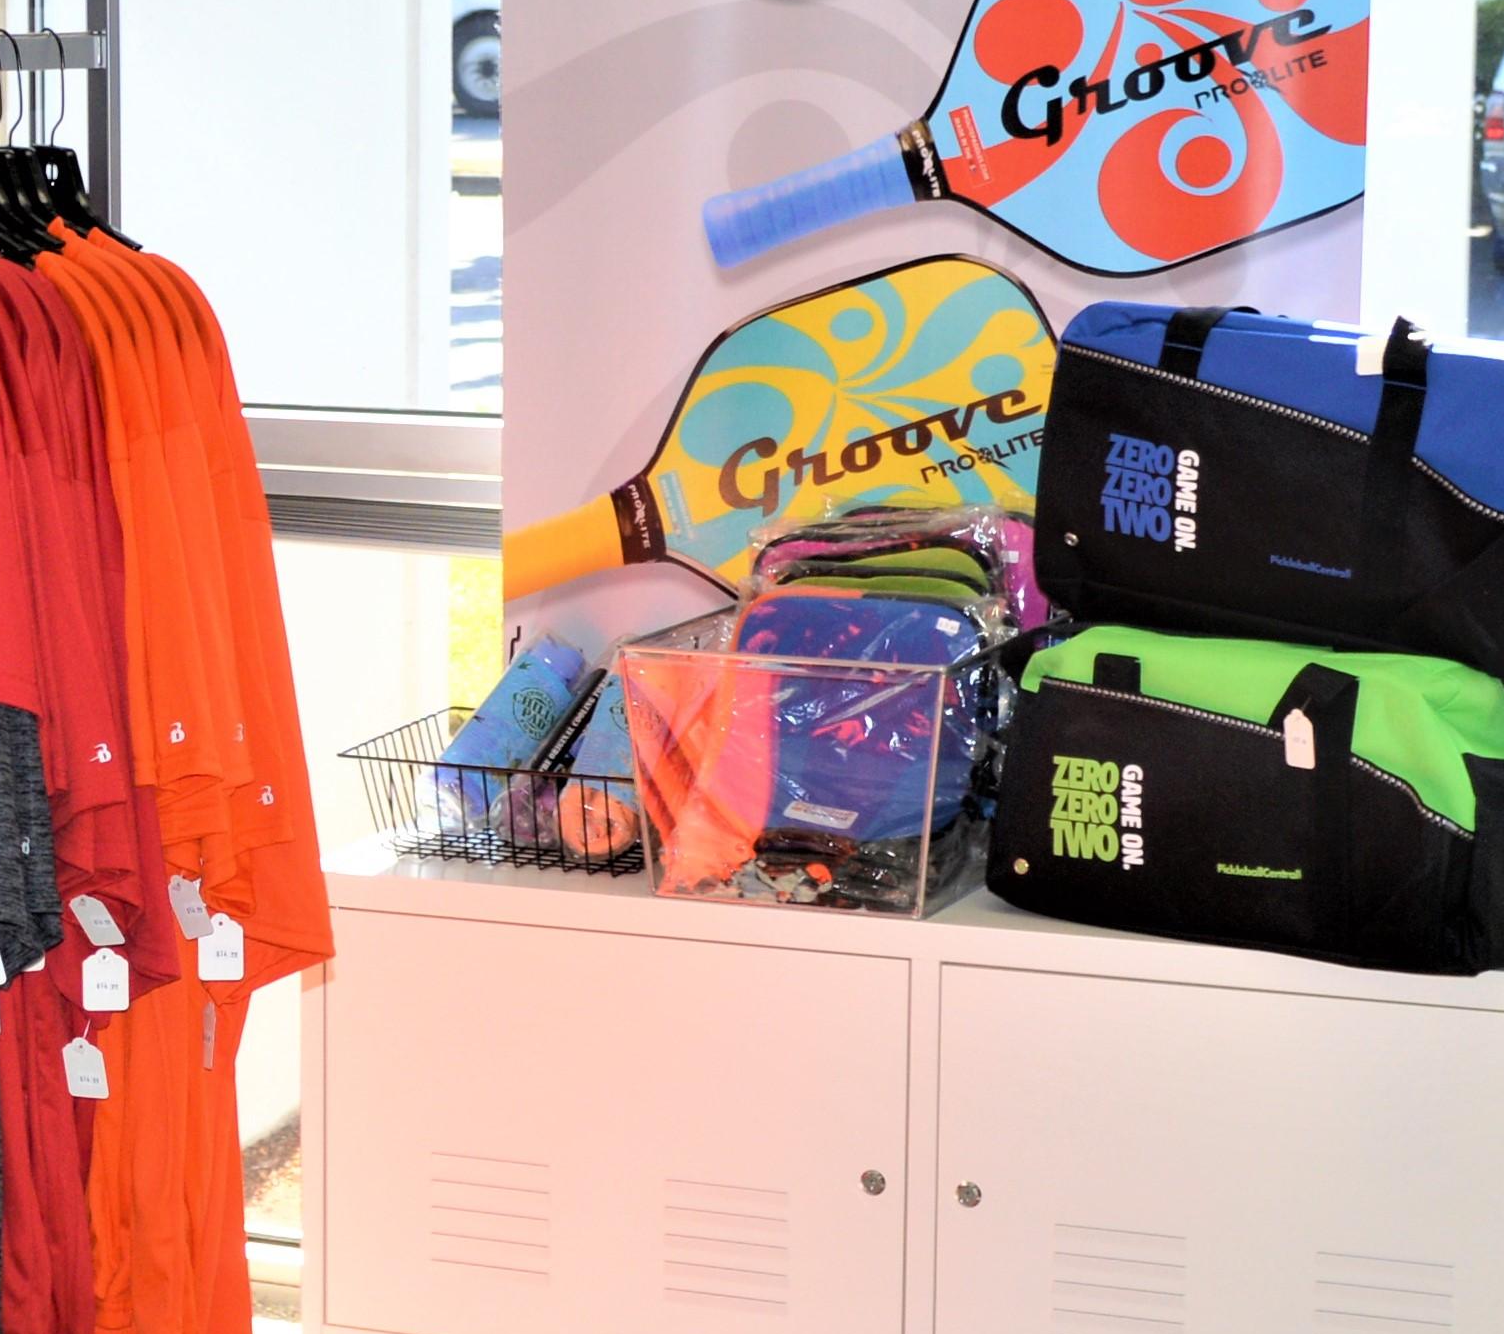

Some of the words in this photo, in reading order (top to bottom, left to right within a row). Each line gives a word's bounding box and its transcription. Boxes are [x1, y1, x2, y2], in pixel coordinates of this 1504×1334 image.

[1001, 8, 1332, 147] Groove
[718, 389, 1043, 517] Groove
[1105, 433, 1174, 475] ZERO
[1102, 464, 1172, 506] ZERO
[1175, 449, 1200, 514] GAME
[1100, 495, 1171, 542] TWO
[1175, 516, 1196, 552] ON.
[548, 725, 575, 761] ORIGINAL
[571, 695, 596, 728] COOLING
[1052, 755, 1119, 793] ZERO
[1121, 763, 1144, 829] GAME
[1051, 787, 1118, 825] ZERO
[1050, 818, 1119, 862] TWO
[1121, 833, 1144, 870] ON.
